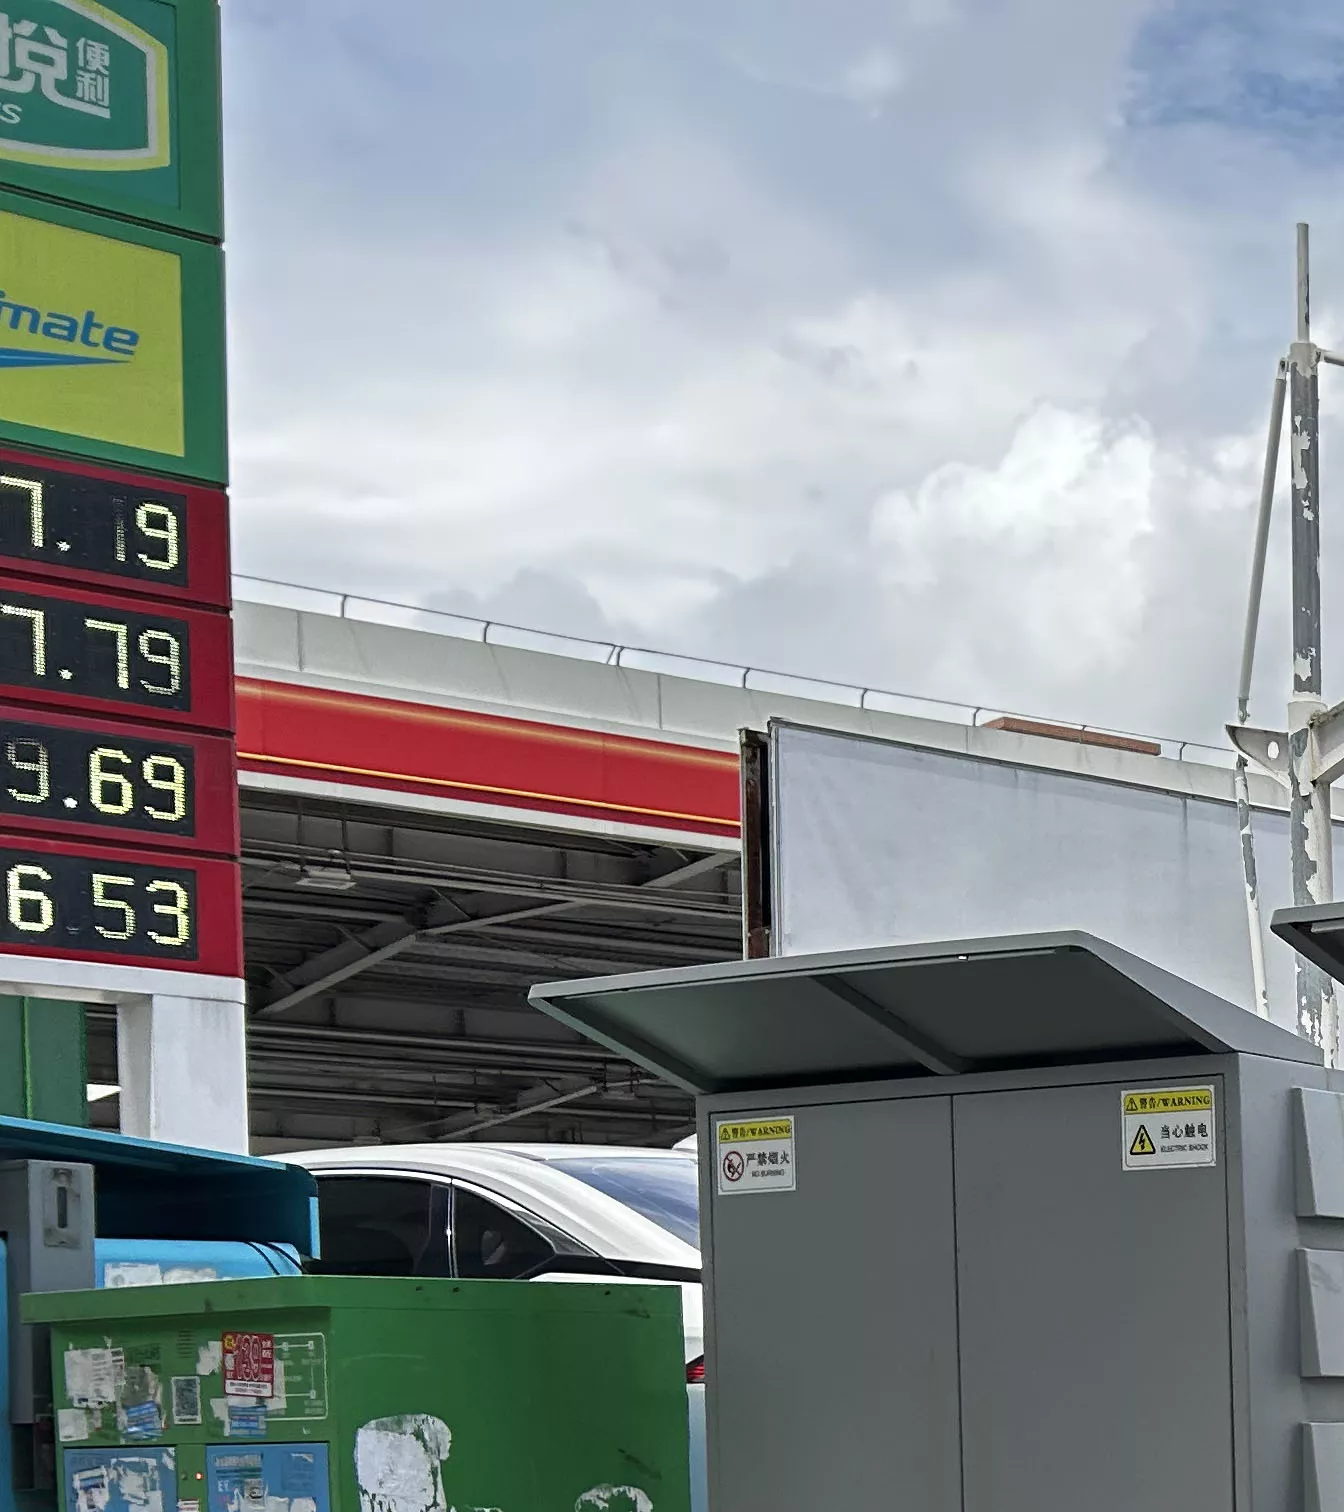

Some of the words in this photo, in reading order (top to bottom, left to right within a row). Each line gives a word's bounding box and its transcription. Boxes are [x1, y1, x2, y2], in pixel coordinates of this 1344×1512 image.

[0, 290, 140, 356] mate
[0, 603, 180, 695] 7.79
[7, 736, 186, 822] 9.69
[1161, 1123, 1208, 1139] 当心触电
